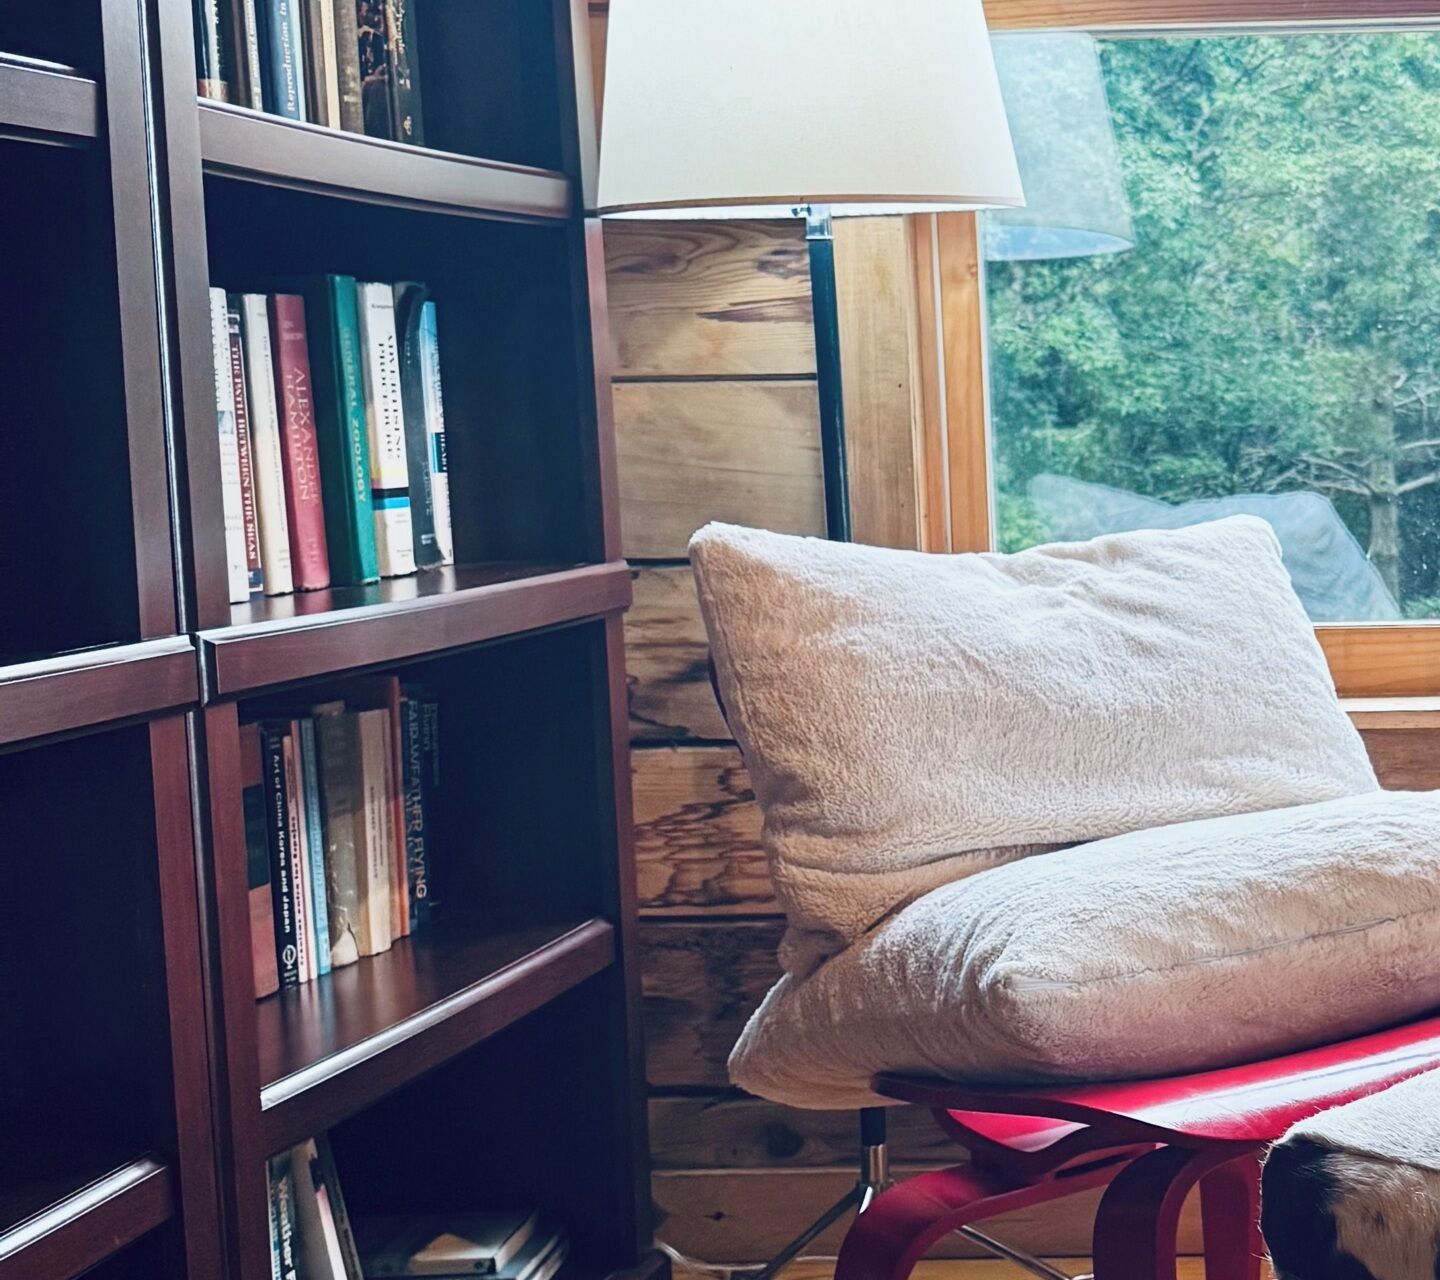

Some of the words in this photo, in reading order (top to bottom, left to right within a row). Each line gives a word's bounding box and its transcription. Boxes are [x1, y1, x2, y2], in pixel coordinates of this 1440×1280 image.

[280, 21, 296, 112] Reproduction
[231, 345, 241, 375] THE
[234, 377, 245, 416] PATH
[344, 326, 357, 410] GENERAL
[352, 417, 365, 502] ZOOLOGY
[237, 418, 251, 490] BETWEEN
[285, 373, 309, 501] HAMILTON
[242, 492, 253, 520] THE
[273, 754, 281, 773] Art
[276, 792, 284, 827] China
[278, 830, 286, 867] Korea
[413, 836, 426, 898] FLYING
[279, 869, 288, 892] and
[282, 895, 291, 933] Japan
[279, 1175, 293, 1268] Weather
